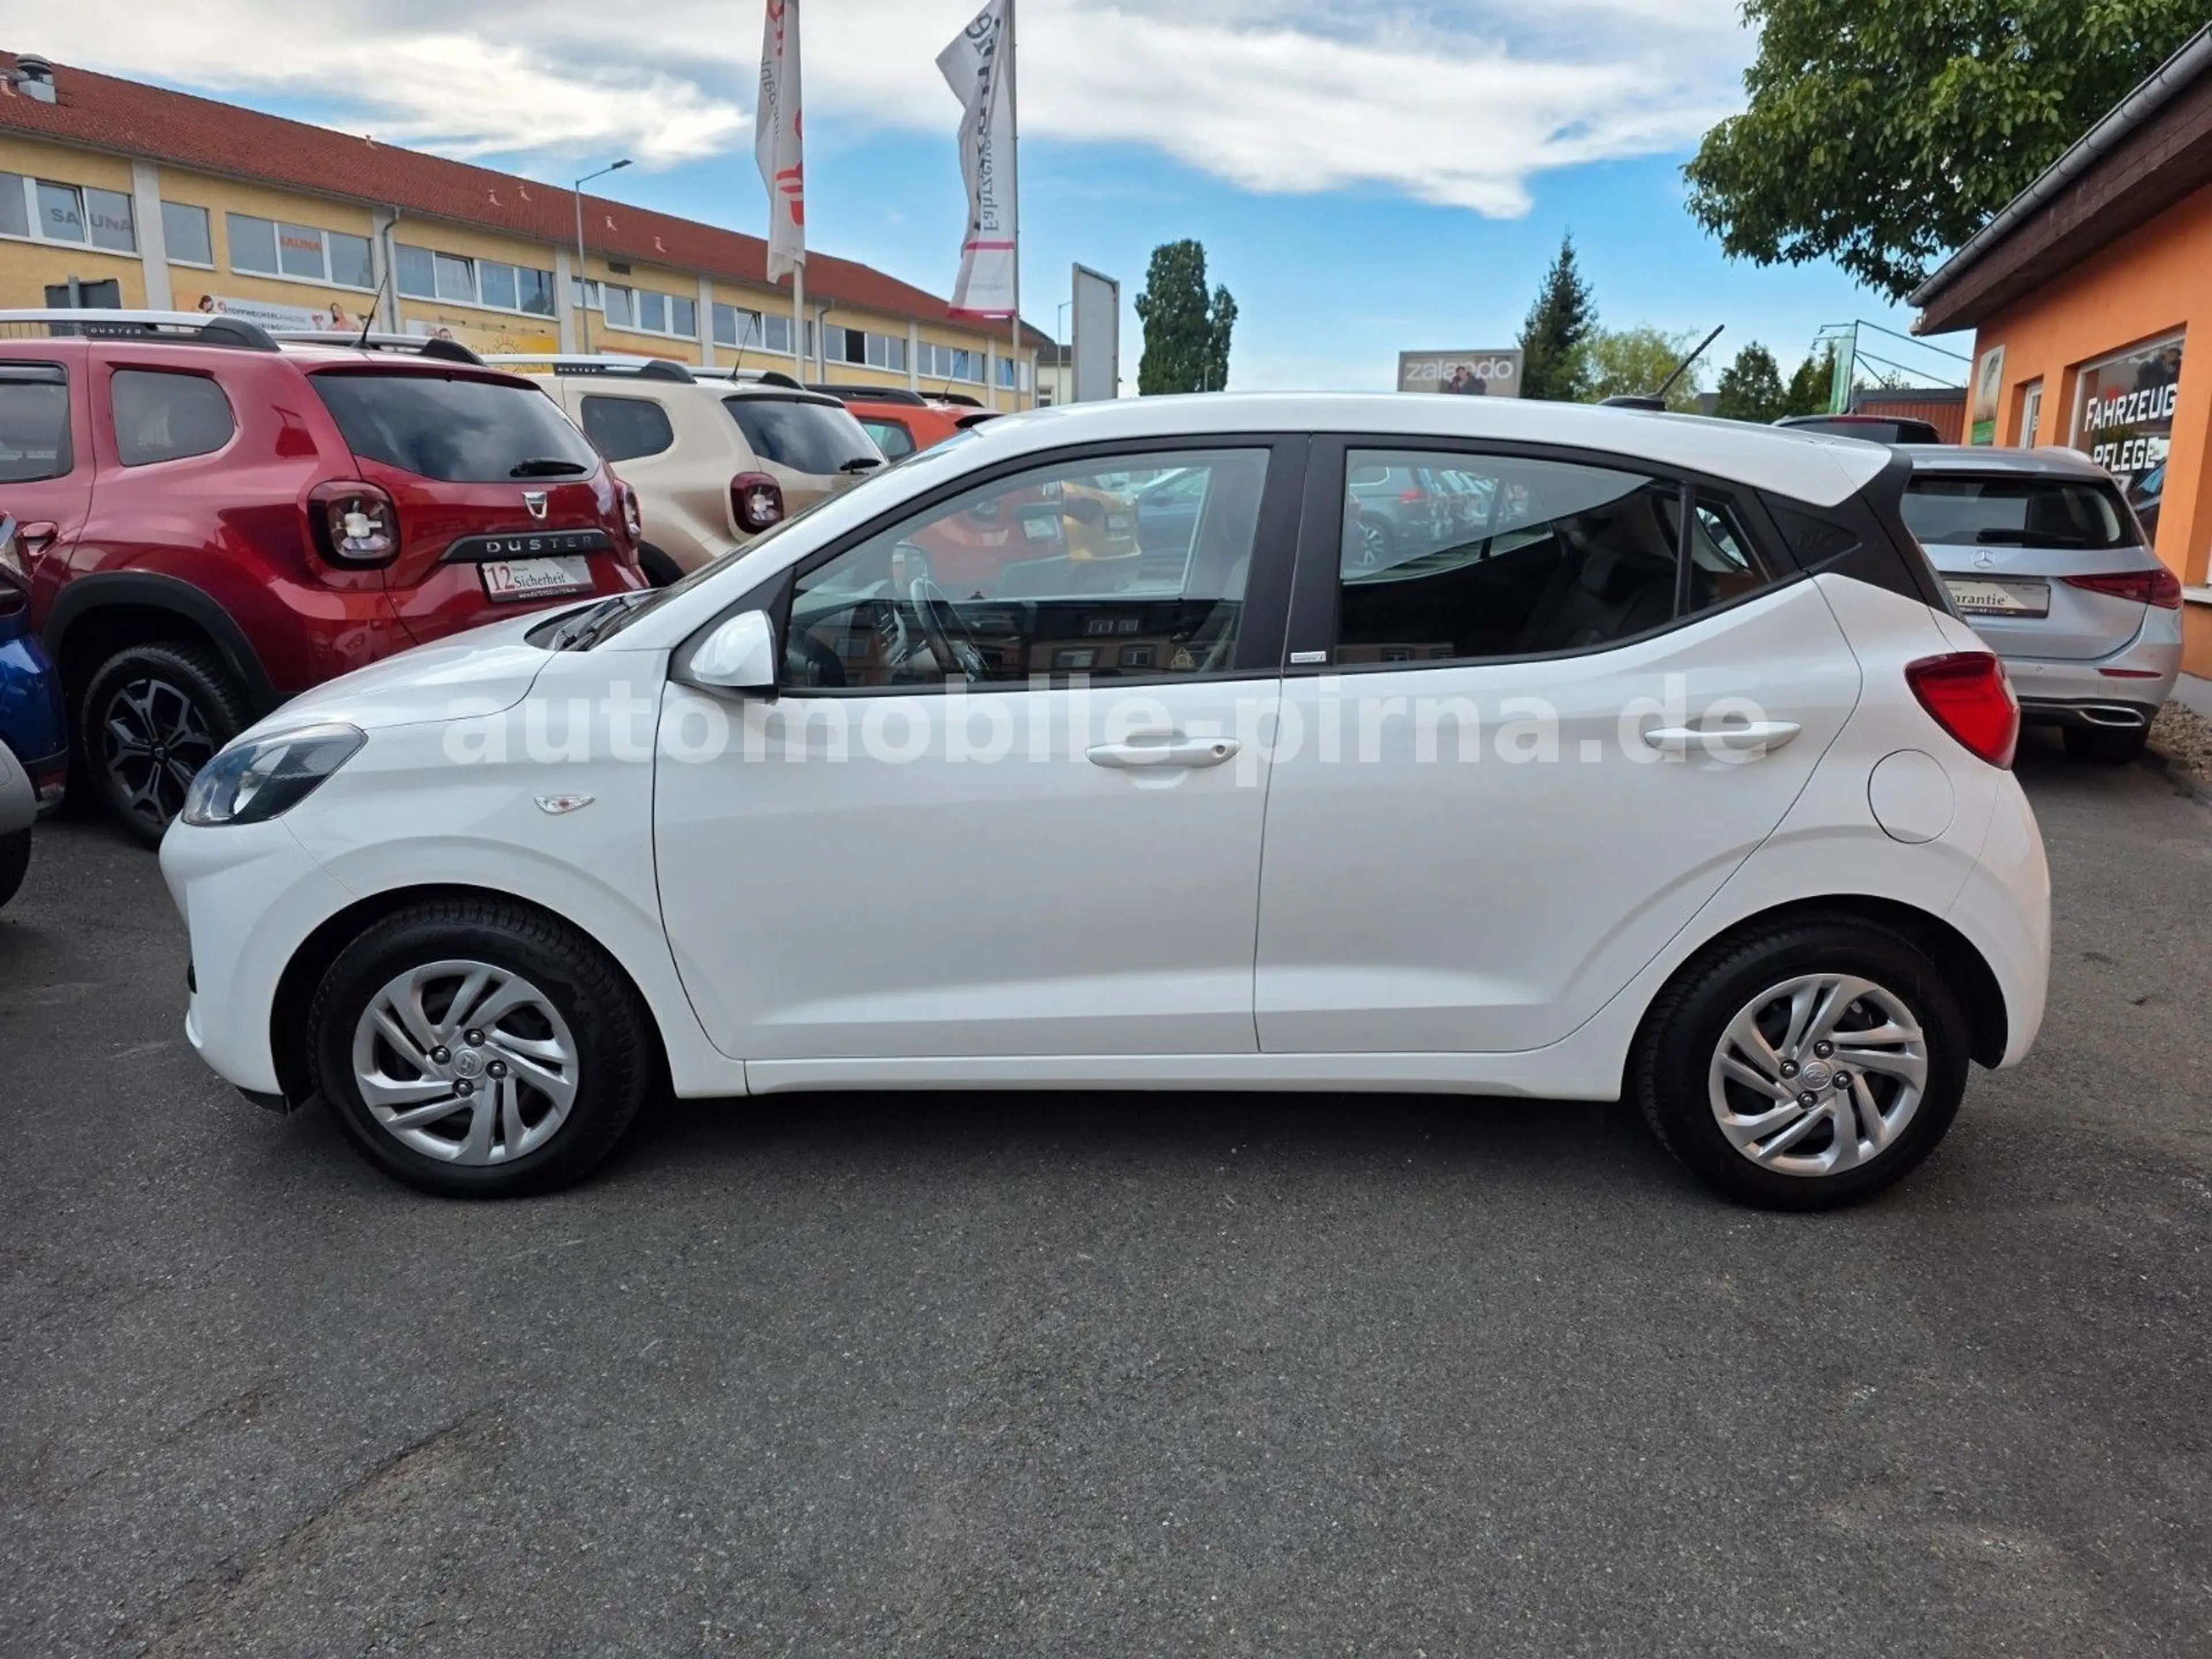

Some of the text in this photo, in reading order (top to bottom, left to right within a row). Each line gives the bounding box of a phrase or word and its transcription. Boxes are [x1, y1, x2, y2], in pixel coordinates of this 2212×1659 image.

[51, 208, 131, 231] SAUNA
[91, 327, 141, 335] DUSTER
[1406, 357, 1513, 381] zalando
[2085, 383, 2177, 432] FAHRZEUG
[2094, 437, 2160, 472] PFLEGE
[487, 536, 592, 552] DUSTER
[487, 565, 566, 591] 12 Sicherheit
[1956, 593, 2005, 605] arantie
